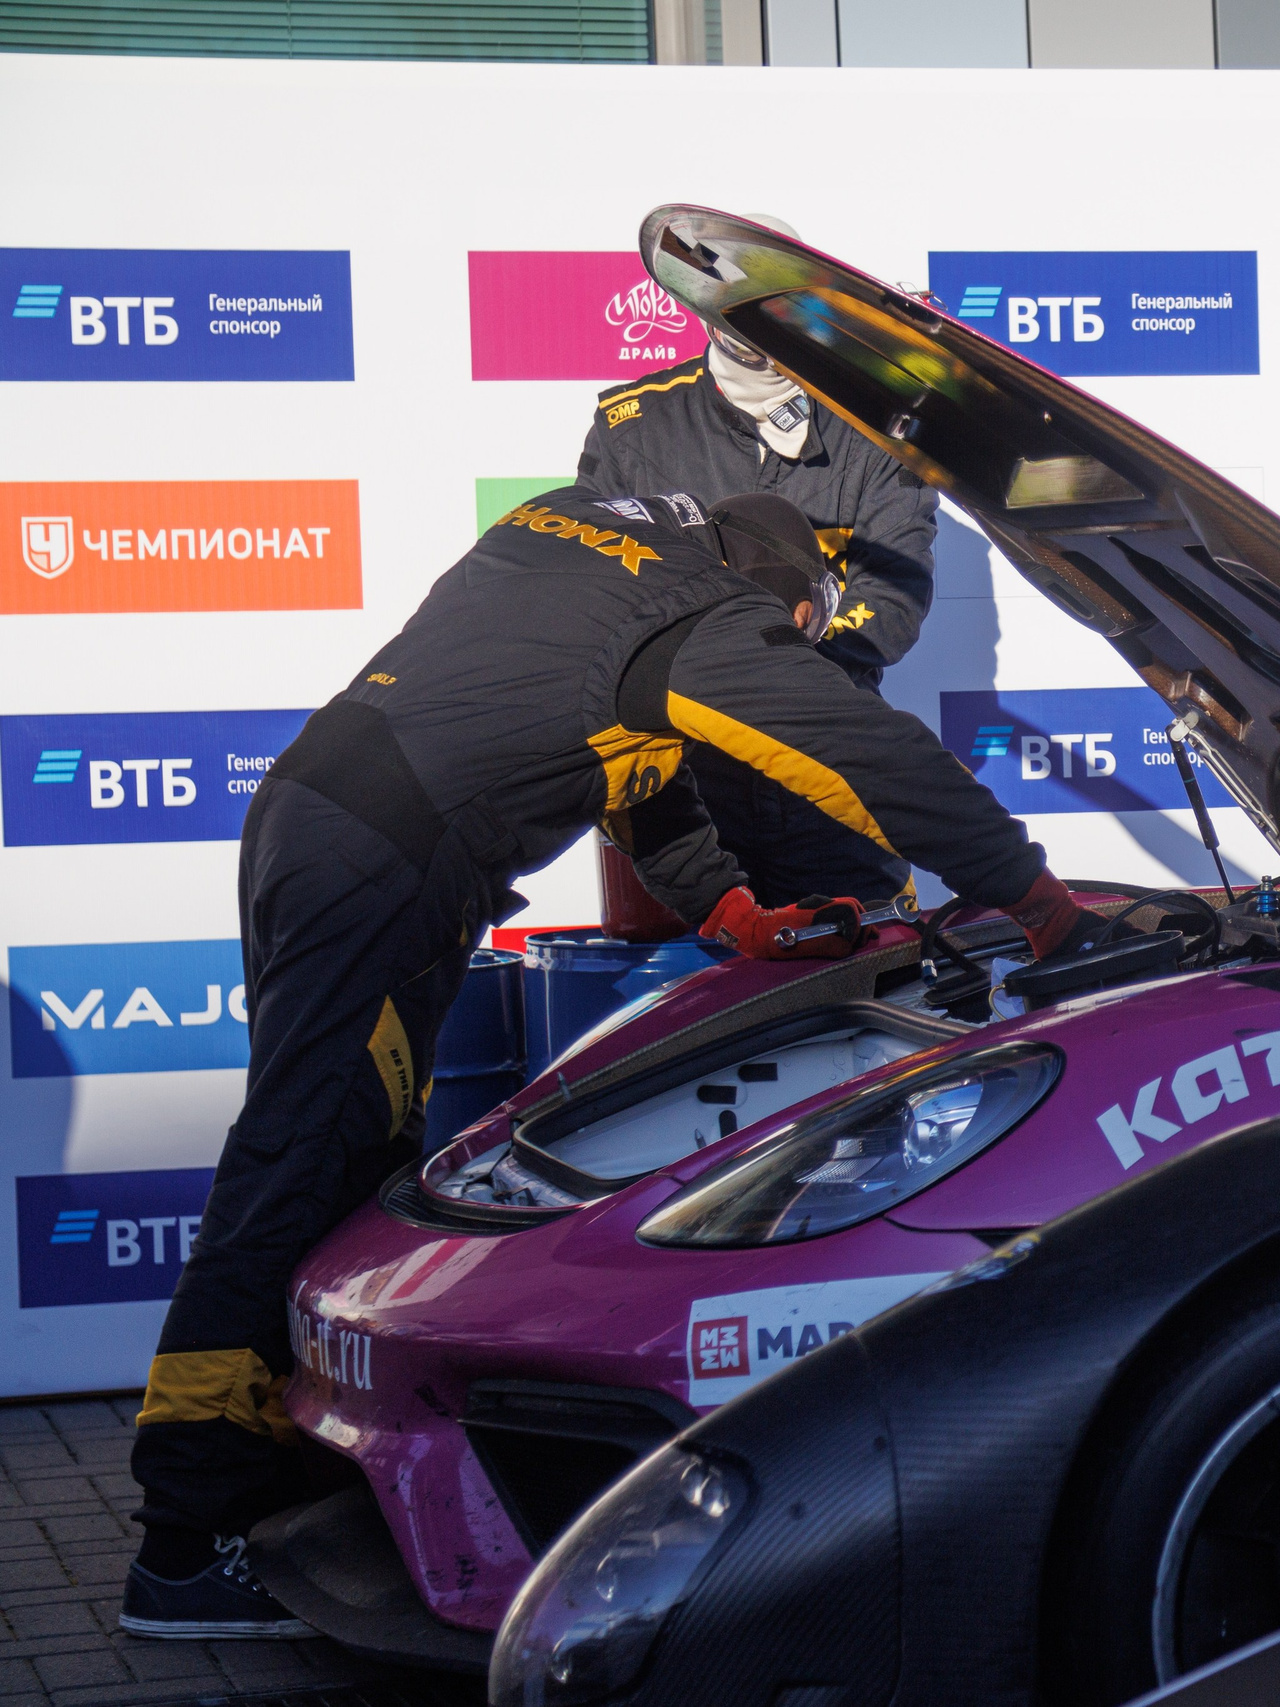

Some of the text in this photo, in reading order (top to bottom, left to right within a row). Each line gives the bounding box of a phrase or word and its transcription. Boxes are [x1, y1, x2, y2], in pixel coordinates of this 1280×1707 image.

[209, 294, 323, 315] Генеральный
[1132, 293, 1233, 313] Генеральный
[70, 297, 179, 345] ВТБ
[210, 319, 281, 338] спонсор
[1008, 297, 1105, 342] ВТБ
[1132, 317, 1196, 334] спонсор
[619, 344, 677, 360] ДРАЙВ
[607, 401, 641, 423] OMP
[83, 527, 331, 561] ЧЕМПИОНАТ
[1021, 733, 1117, 781] ВТБ
[90, 758, 197, 809] ВТБ
